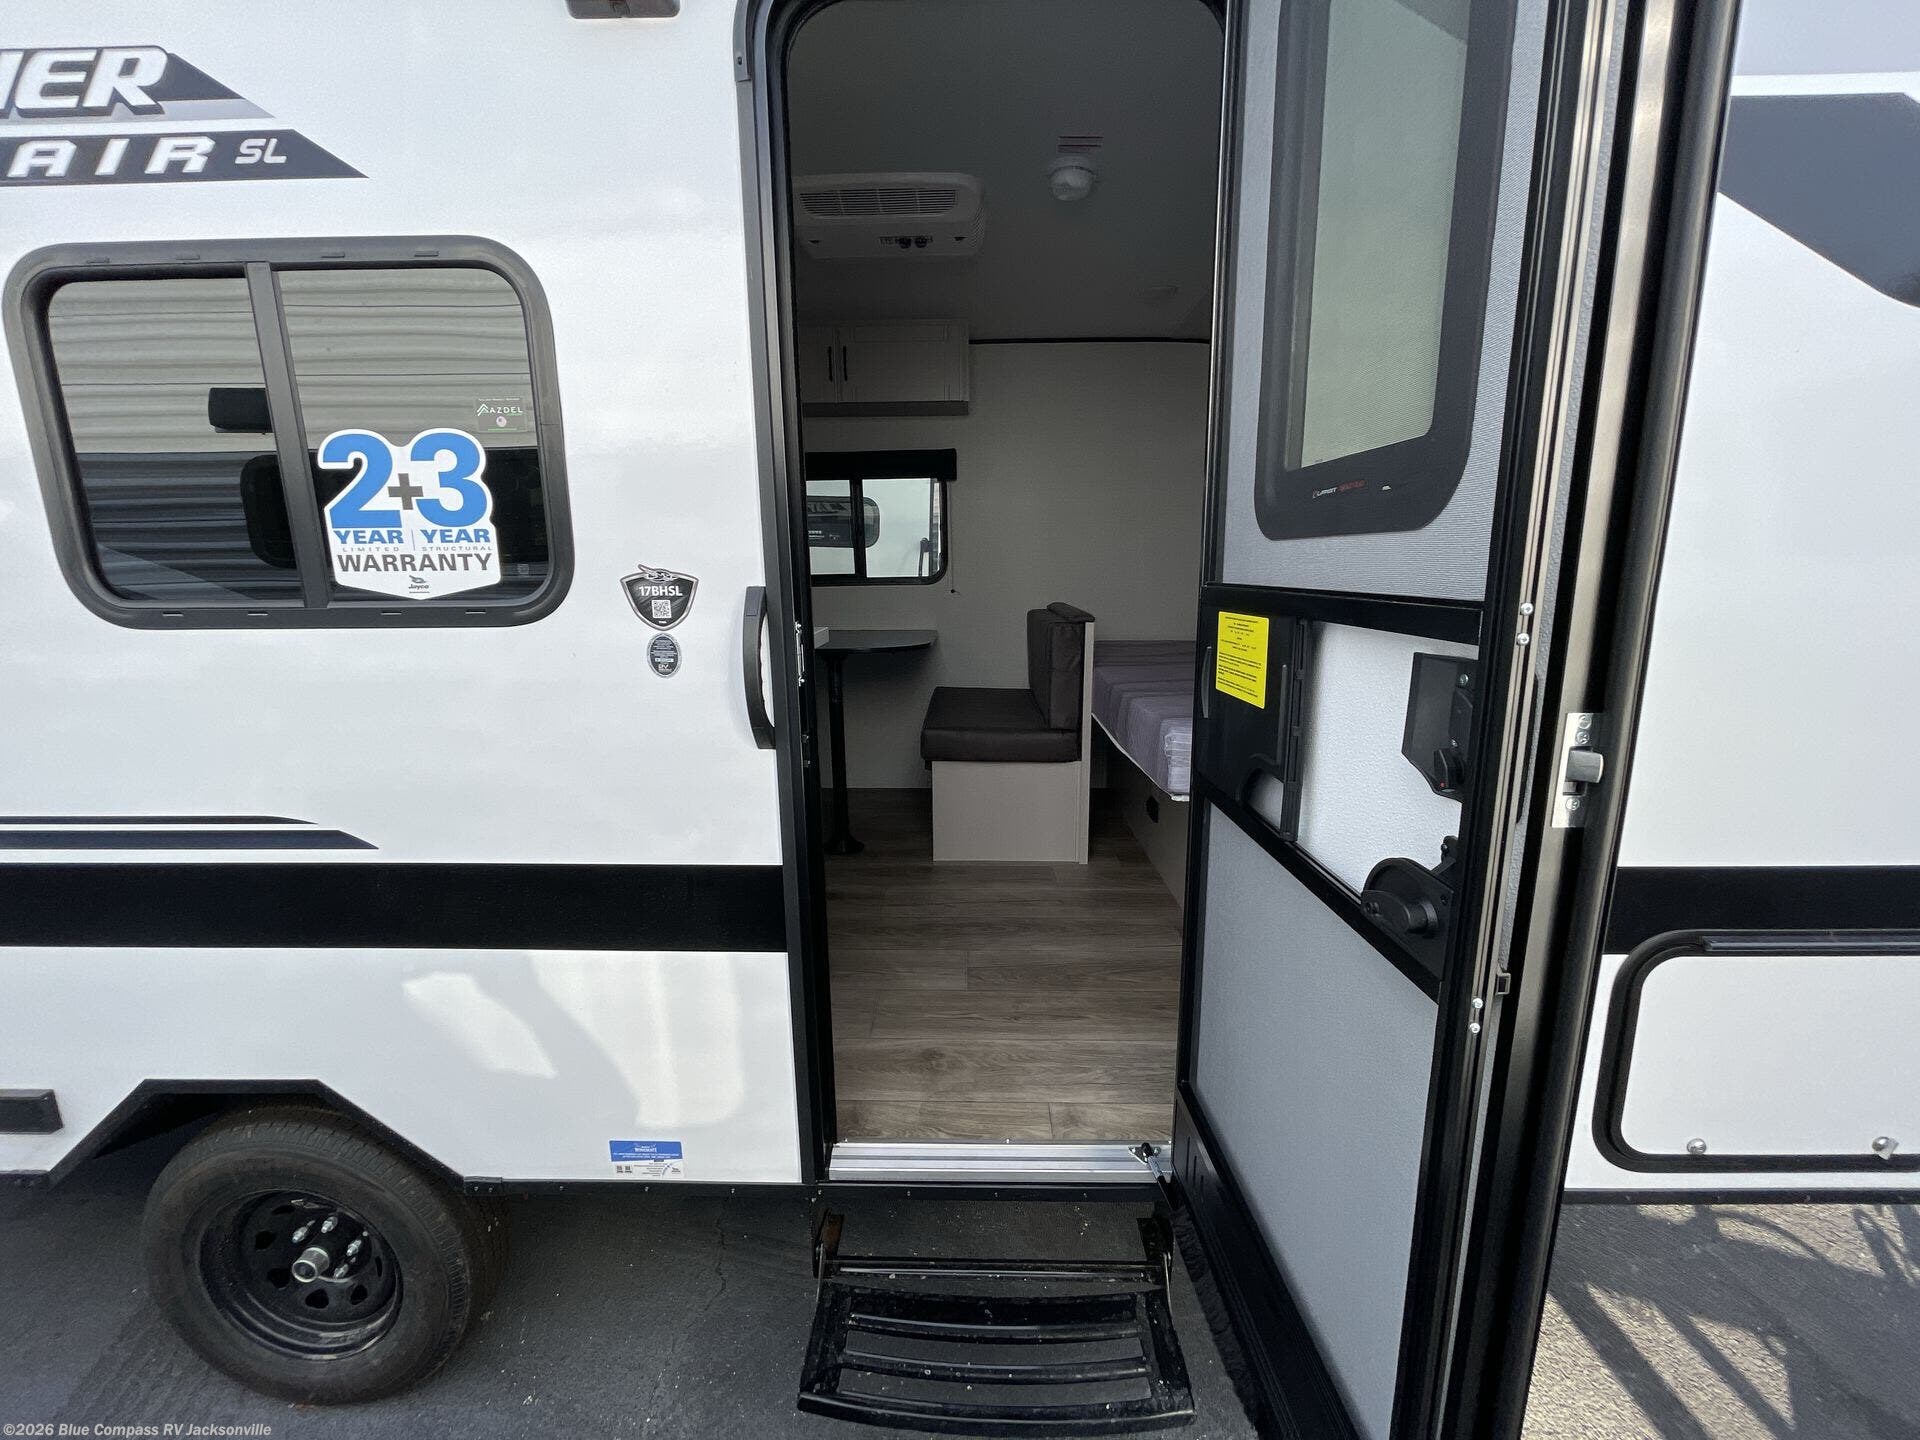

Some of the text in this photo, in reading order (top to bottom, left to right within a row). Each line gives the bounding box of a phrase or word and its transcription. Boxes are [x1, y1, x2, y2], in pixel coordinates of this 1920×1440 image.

[5, 136, 288, 178] AIR SL
[333, 528, 491, 544] YEAR YEAR
[337, 553, 492, 572] WARRANTY
[638, 585, 683, 597] 17BHSL
